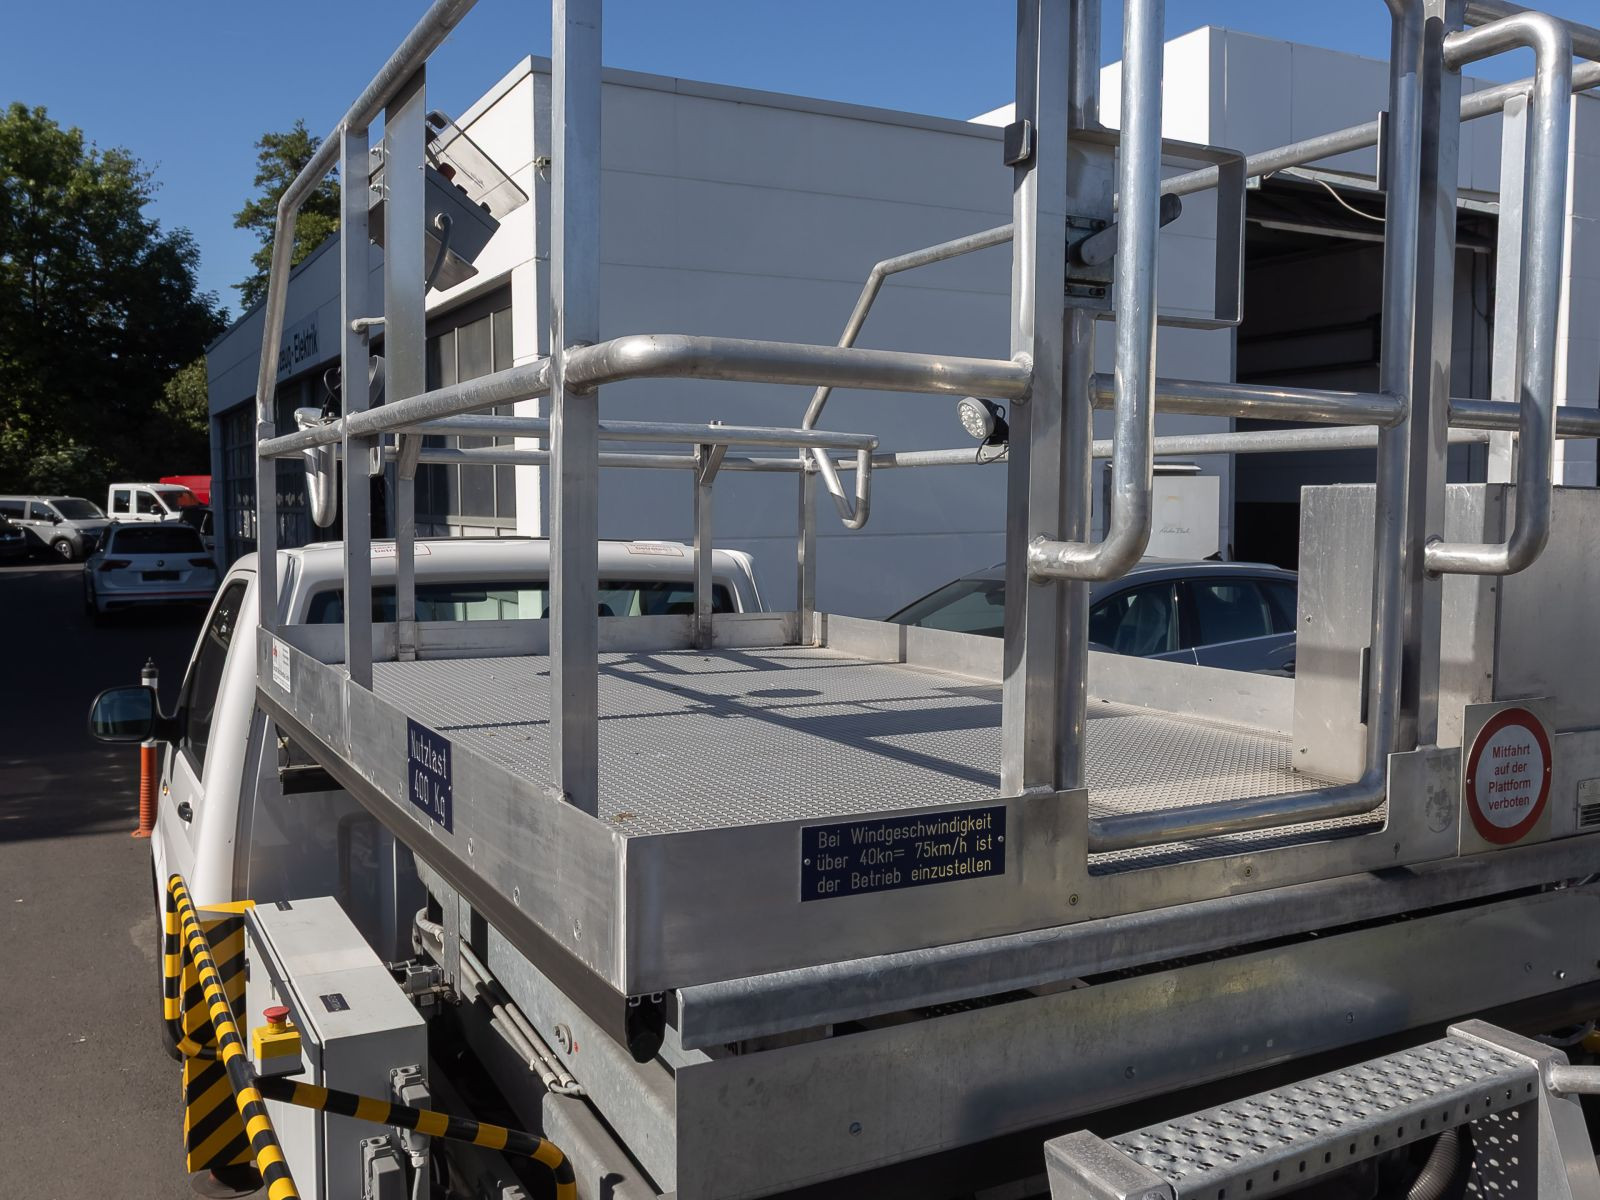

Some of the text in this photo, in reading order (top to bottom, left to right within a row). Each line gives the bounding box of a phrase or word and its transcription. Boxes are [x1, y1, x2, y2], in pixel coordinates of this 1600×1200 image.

[411, 728, 447, 779] Nutzlast
[1492, 744, 1531, 759] Mitfahrt
[1494, 761, 1528, 776] auf der
[415, 769, 446, 826] 400 Kg
[1488, 779, 1531, 794] Plattform
[1488, 795, 1530, 811] verboten
[818, 813, 992, 849] Bei Windgeschwindigkeit
[817, 854, 848, 871] über
[915, 837, 967, 859] 75km/h
[976, 834, 992, 852] ist
[817, 857, 992, 893] der Betrieb einzustellen
